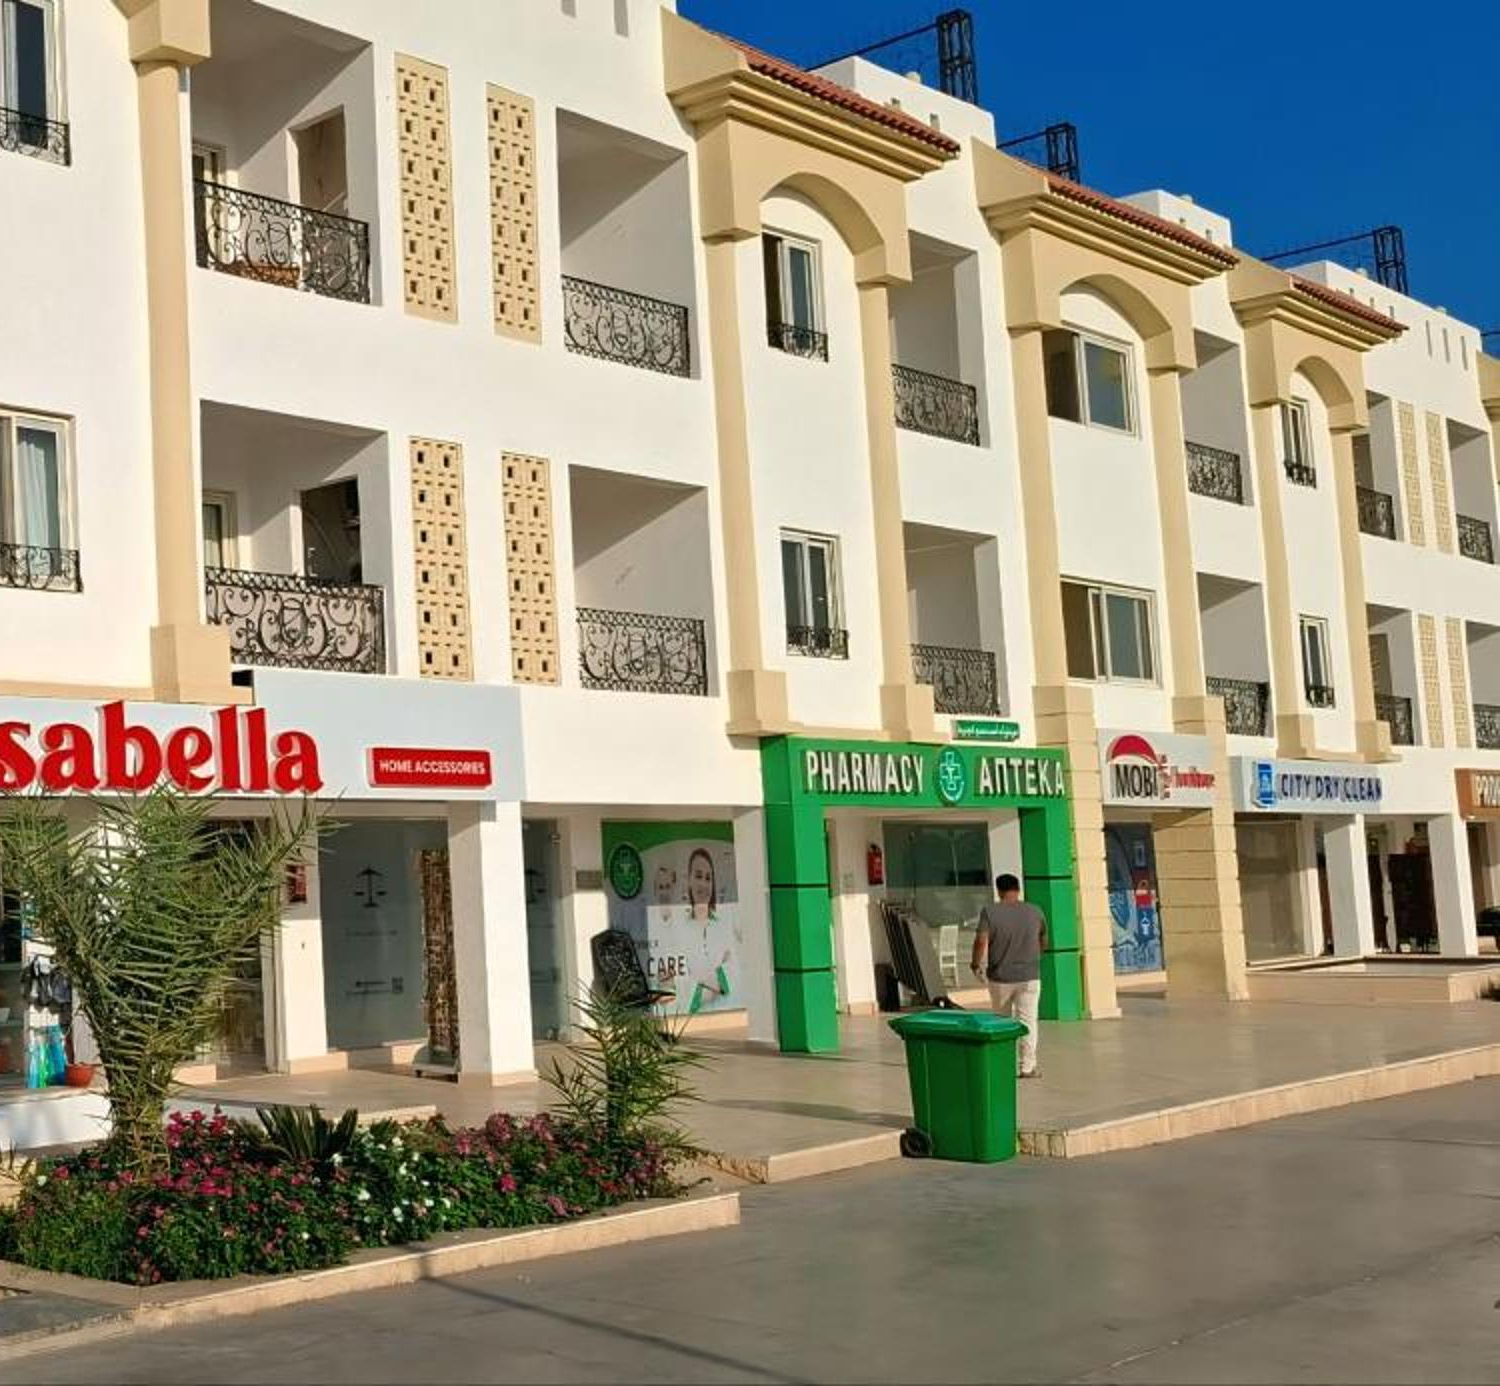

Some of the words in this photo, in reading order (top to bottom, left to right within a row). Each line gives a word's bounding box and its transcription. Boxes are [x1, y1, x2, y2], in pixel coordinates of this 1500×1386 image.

[380, 759, 414, 773] HOME
[415, 760, 485, 775] ACCESSORIES
[805, 750, 924, 794] PHARMACY
[979, 757, 1066, 796] АПТЕКА
[1113, 763, 1159, 798] MOBI
[1281, 773, 1311, 798] CITY
[1315, 775, 1339, 798] DRY
[1343, 776, 1382, 801] CLEAN
[647, 955, 686, 978] CARE
